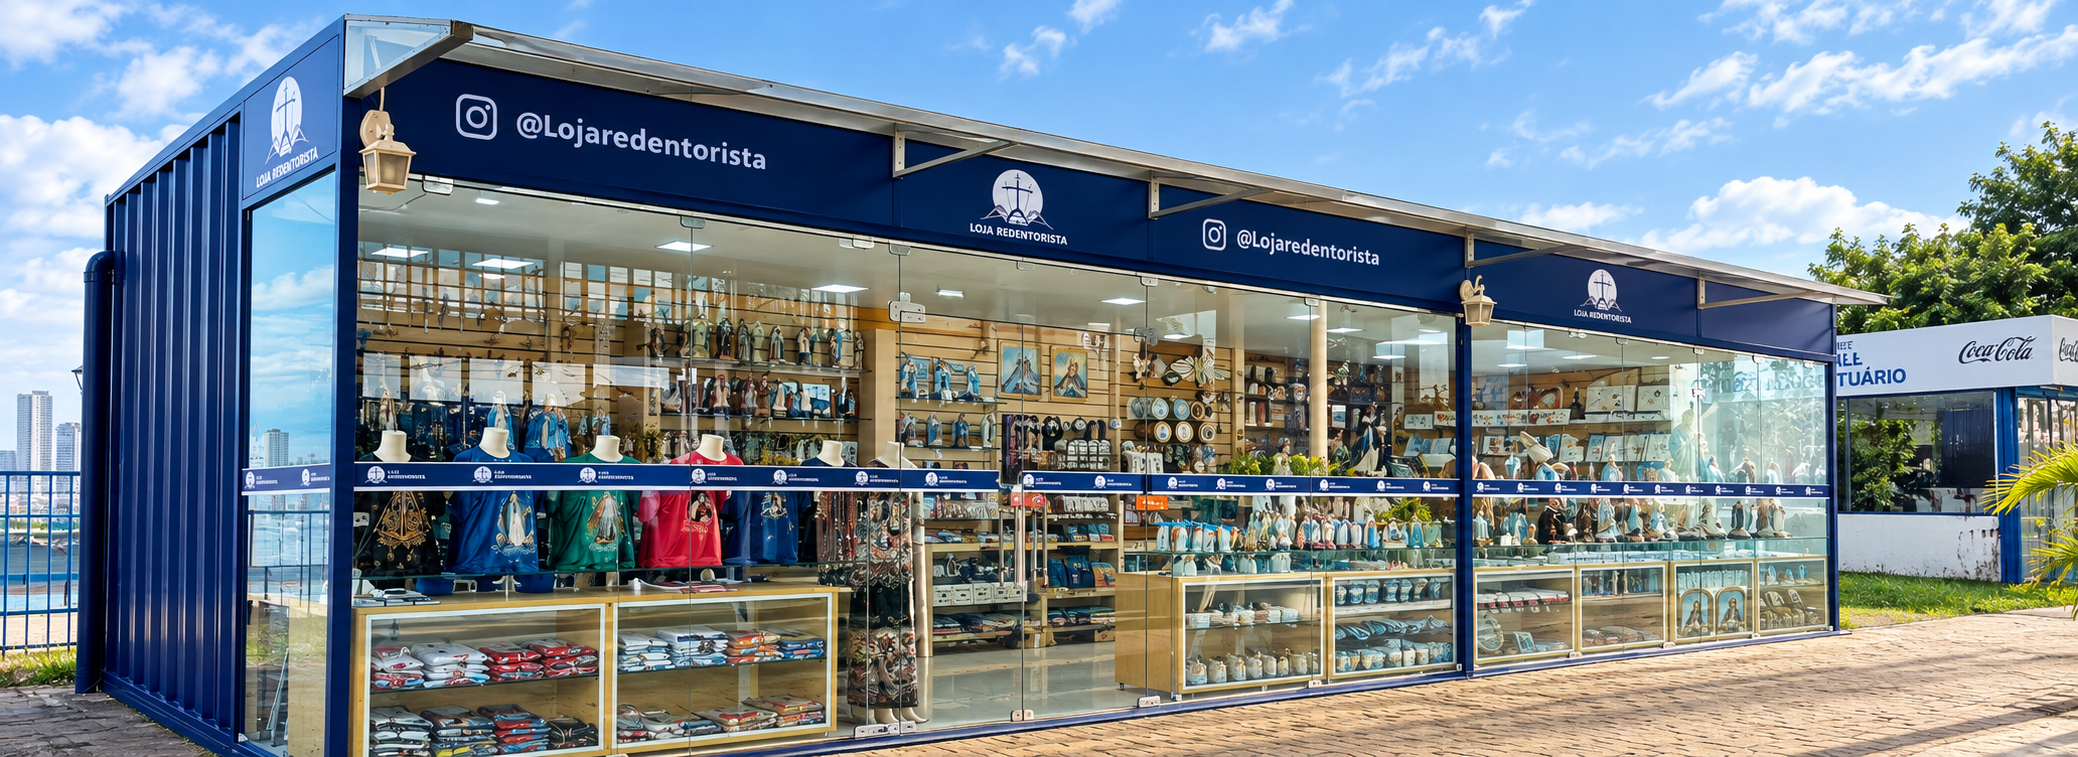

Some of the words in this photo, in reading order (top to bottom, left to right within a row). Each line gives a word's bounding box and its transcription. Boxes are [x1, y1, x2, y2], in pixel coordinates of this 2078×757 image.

[516, 112, 766, 170] @Lojaredentorista
[256, 171, 271, 188] LOJA
[969, 223, 994, 236] LOJA
[996, 227, 1068, 245] REDENTORISTA
[1237, 229, 1380, 266] @Lojaredentorista
[1958, 336, 2037, 364] Coca-Cola
